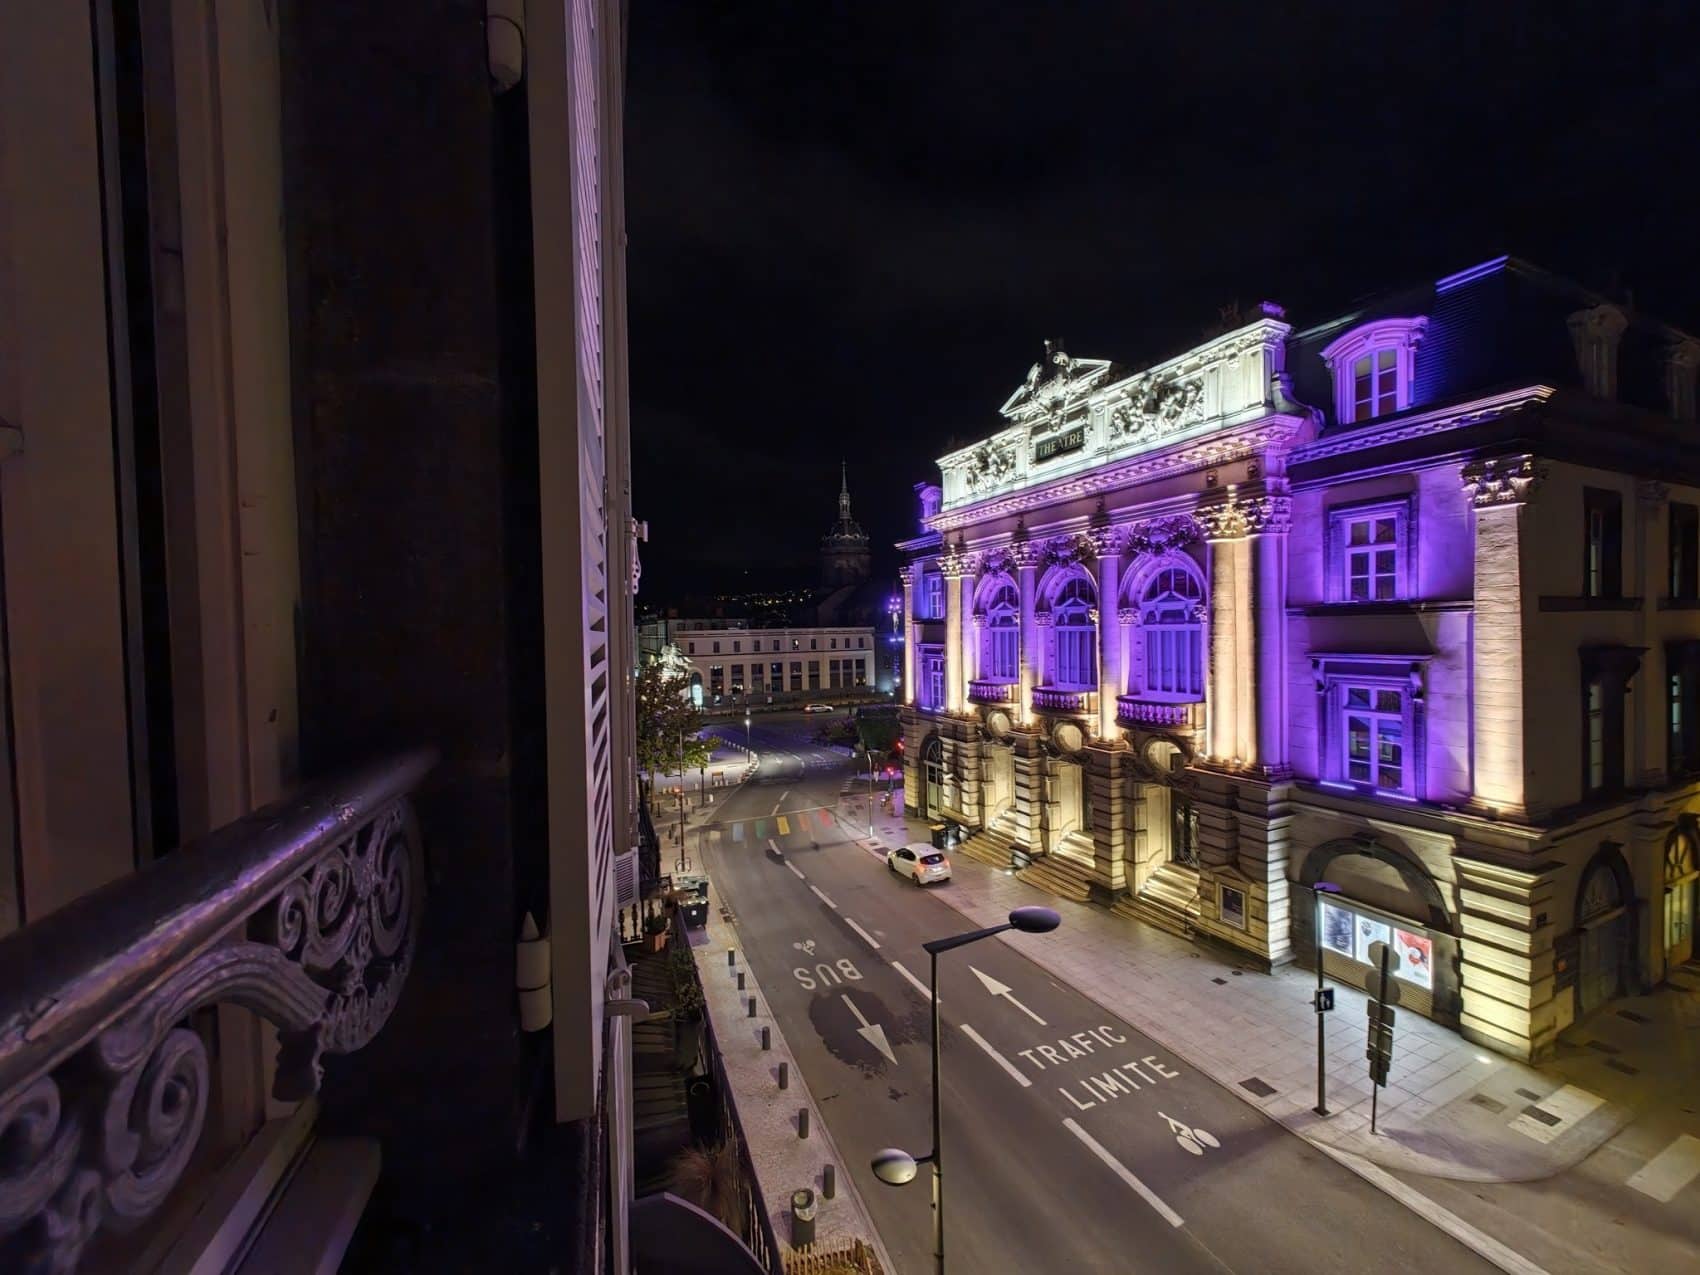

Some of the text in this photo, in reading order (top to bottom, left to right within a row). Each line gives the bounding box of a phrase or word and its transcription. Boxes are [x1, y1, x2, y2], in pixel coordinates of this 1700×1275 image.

[793, 958, 863, 990] BUS
[1018, 1025, 1126, 1070] TRAFIC
[1058, 1055, 1180, 1110] LIMITE
